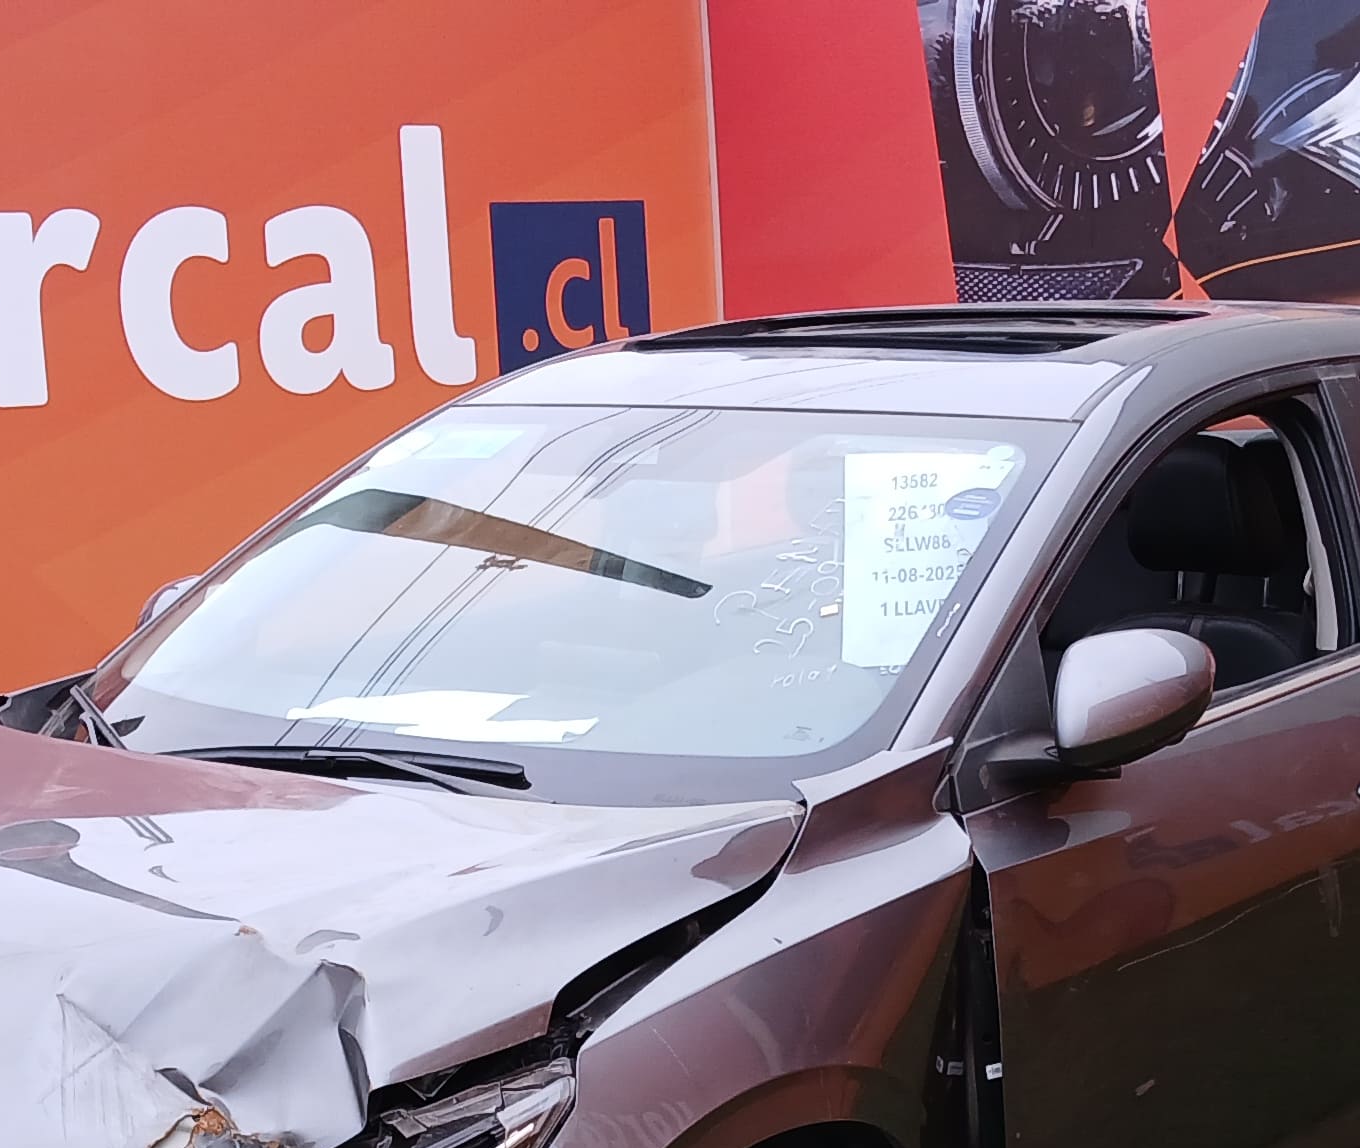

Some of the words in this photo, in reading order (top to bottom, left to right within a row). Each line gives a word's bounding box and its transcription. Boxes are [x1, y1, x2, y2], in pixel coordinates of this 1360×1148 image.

[521, 216, 630, 350] .cl
[891, 472, 938, 491] 13582
[880, 602, 888, 617] 1
